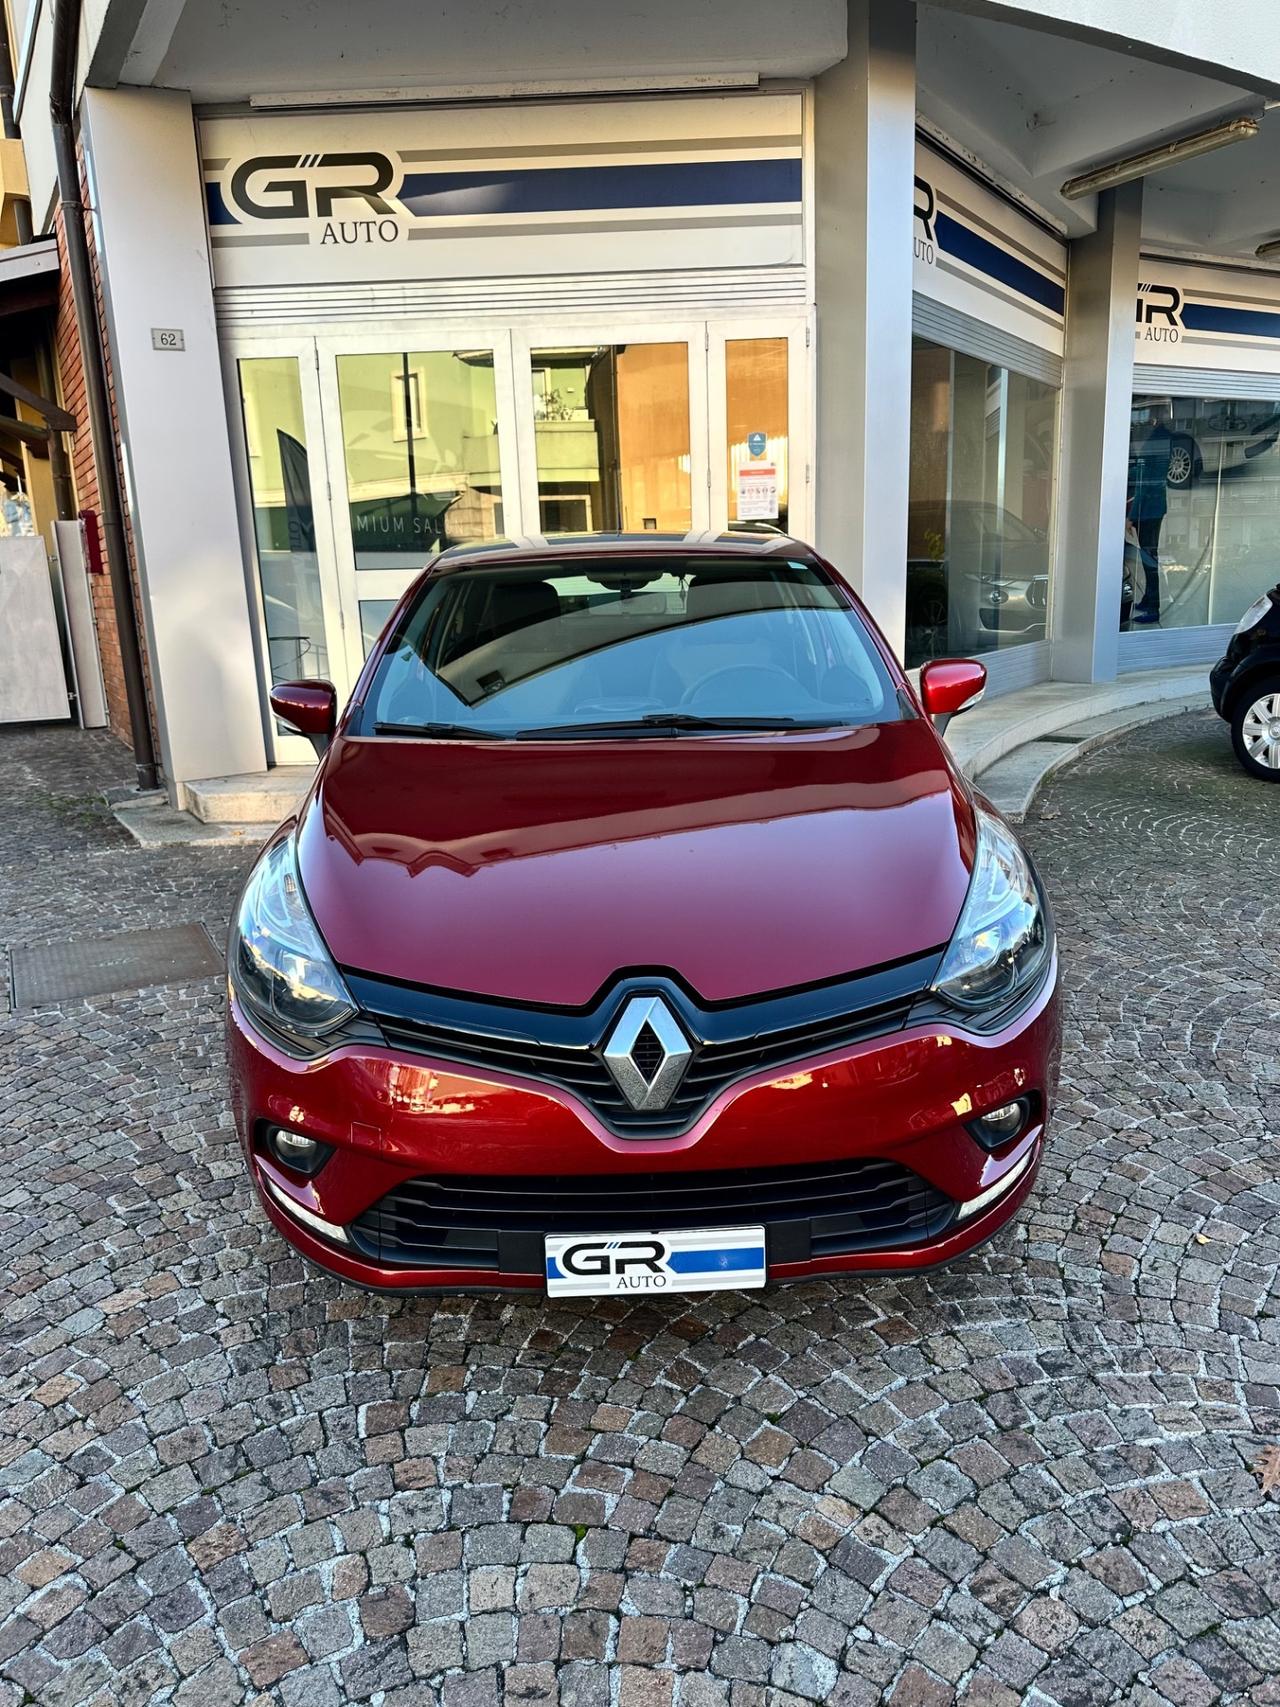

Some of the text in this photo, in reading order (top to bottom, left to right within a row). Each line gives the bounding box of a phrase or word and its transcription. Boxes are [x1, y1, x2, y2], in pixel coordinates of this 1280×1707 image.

[231, 152, 396, 219] GR
[914, 174, 934, 241] R
[320, 219, 399, 245] AUTO
[914, 237, 934, 265] UTO
[1136, 283, 1181, 326] R
[160, 332, 177, 346] 62
[1144, 326, 1179, 343] AUTO
[356, 514, 405, 534] MIUM
[562, 1240, 666, 1276] GR
[616, 1275, 667, 1289] AUTO
